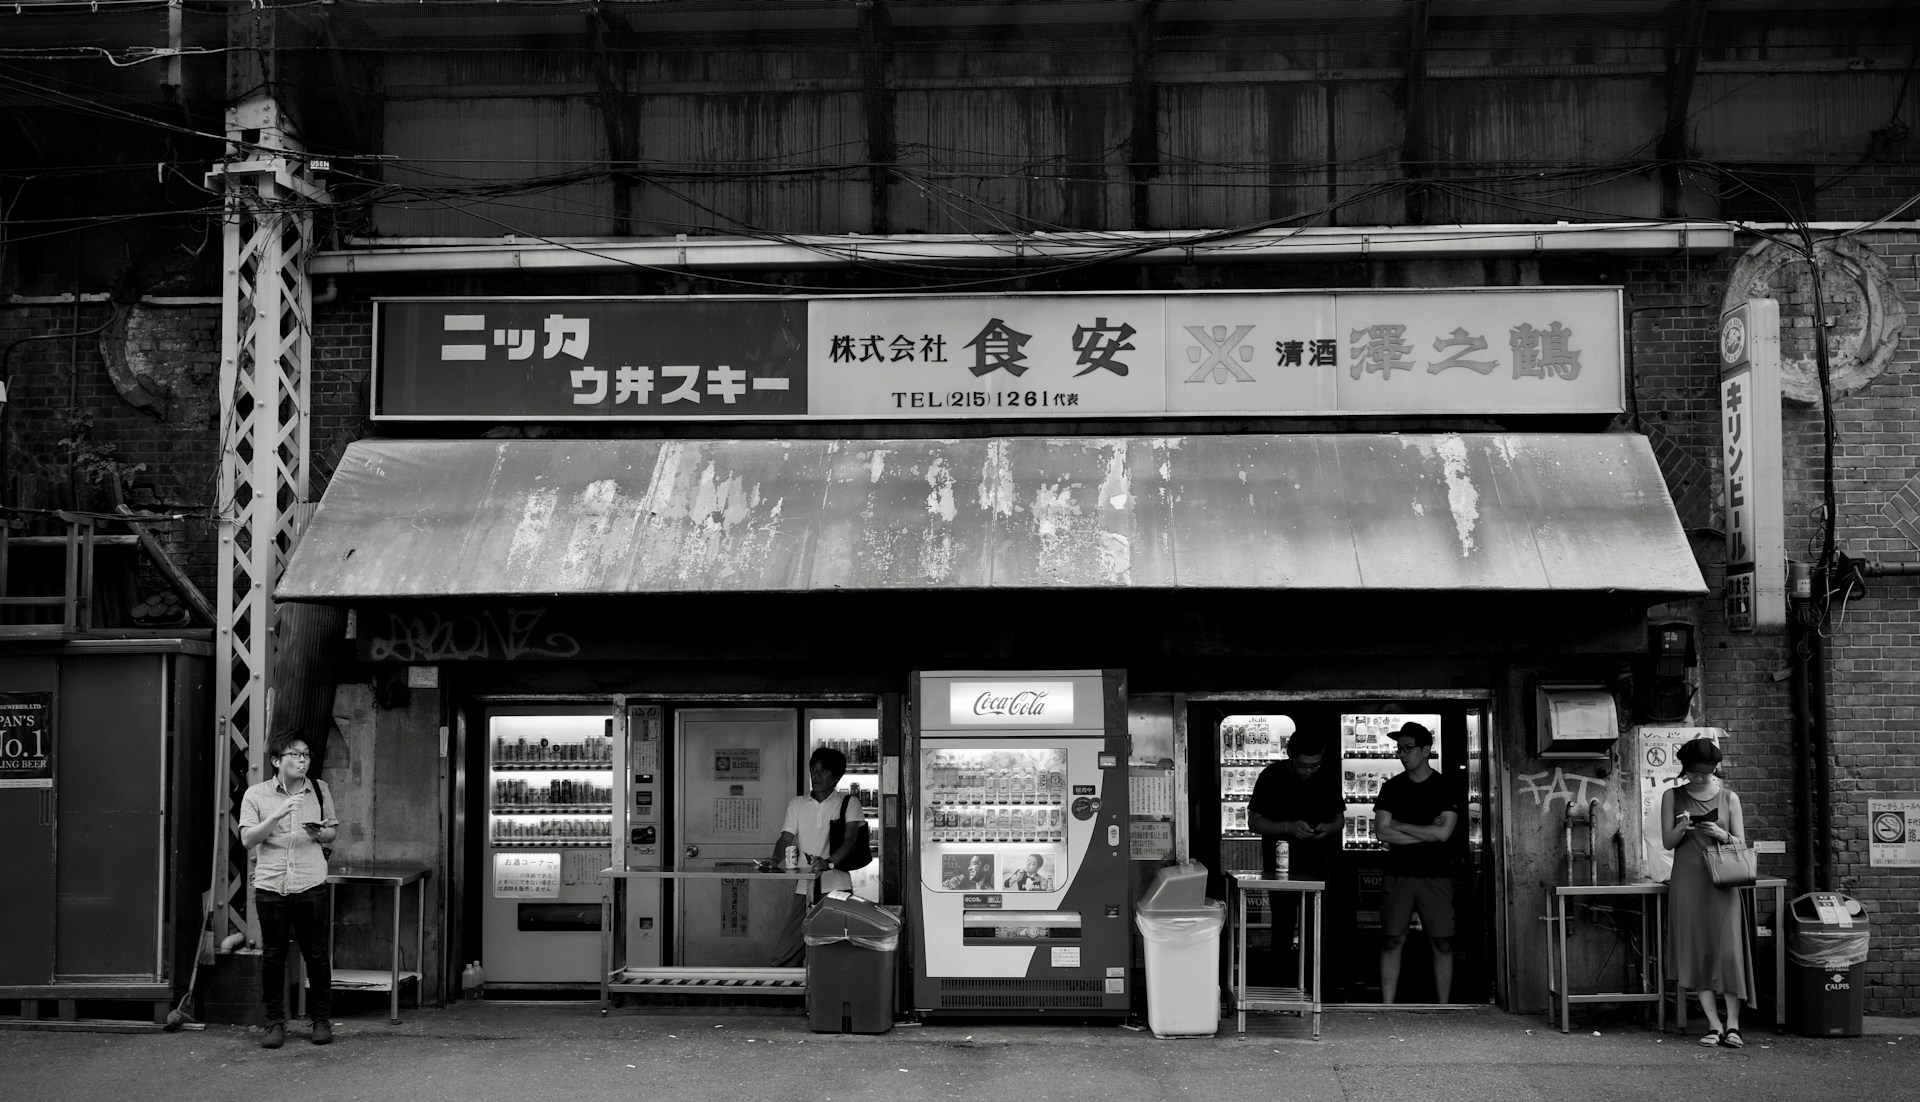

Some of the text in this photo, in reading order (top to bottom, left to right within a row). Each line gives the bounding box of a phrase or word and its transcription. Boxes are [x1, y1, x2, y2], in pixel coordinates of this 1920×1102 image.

[310, 160, 330, 168] USEN
[441, 314, 590, 361] ニッカ
[829, 334, 948, 363] 株式会社
[1349, 320, 1582, 381] 澤之鶴
[1275, 338, 1337, 367] 清酒
[1726, 381, 1747, 561] キリンビール
[973, 691, 1049, 716] Coca-Cola
[22, 759, 47, 769] BEER
[1825, 983, 1850, 991] CALPIS
